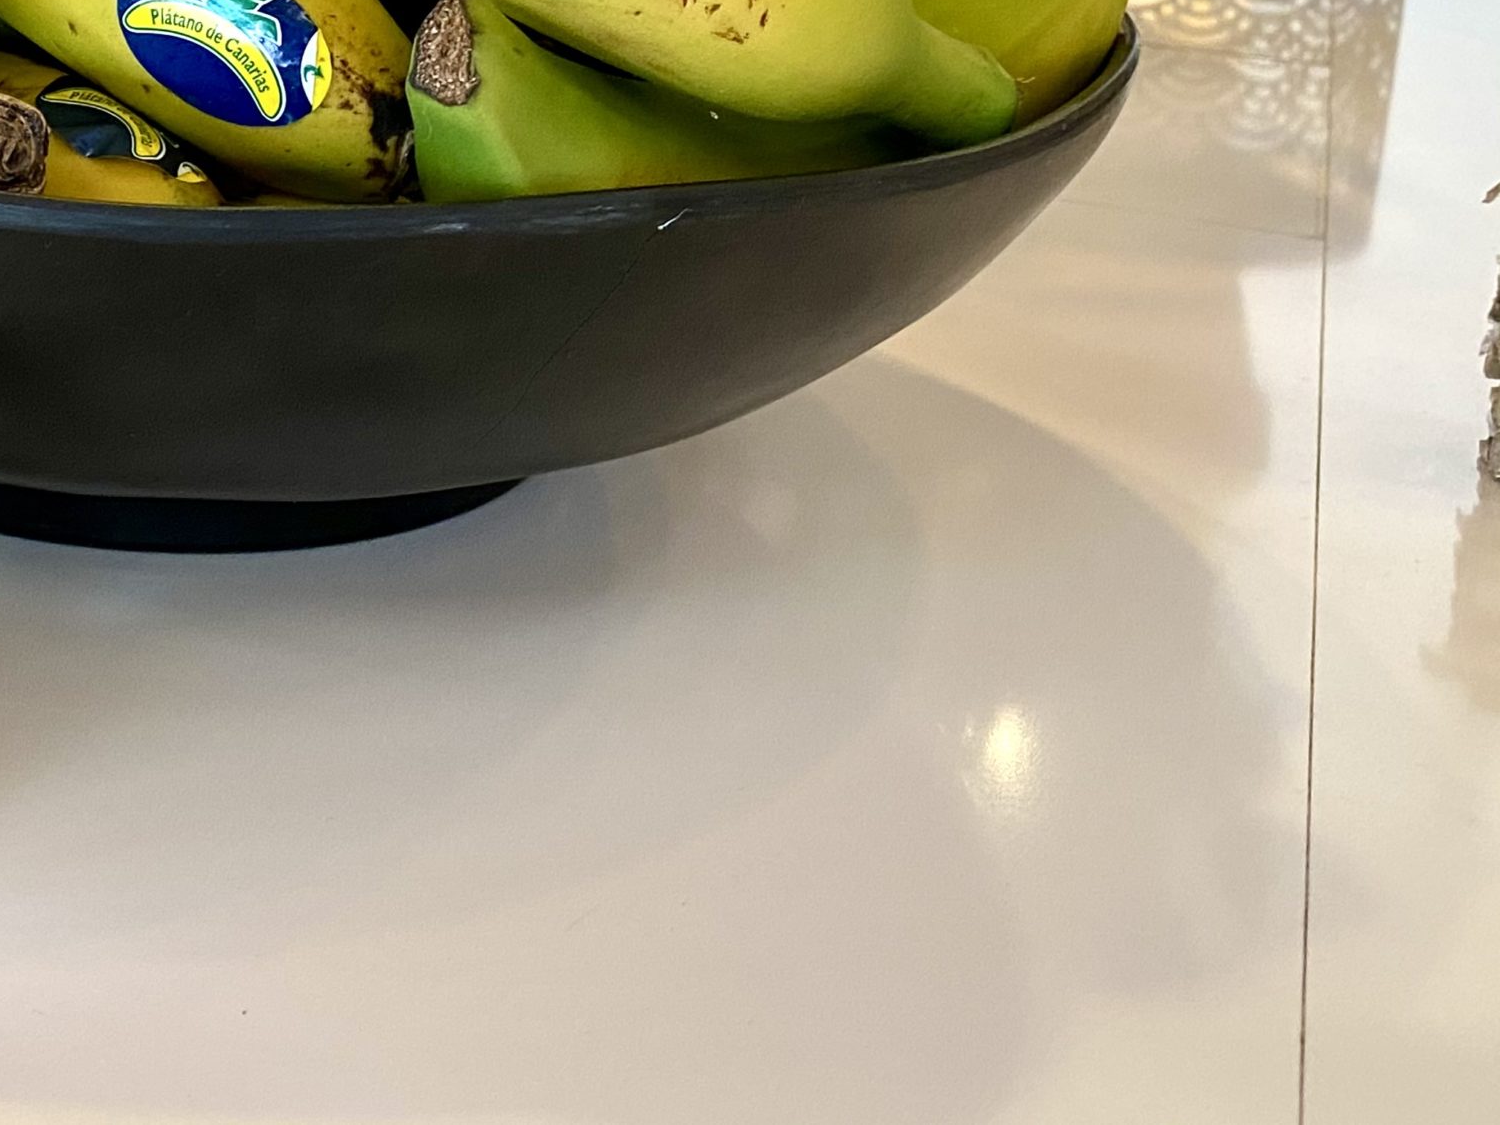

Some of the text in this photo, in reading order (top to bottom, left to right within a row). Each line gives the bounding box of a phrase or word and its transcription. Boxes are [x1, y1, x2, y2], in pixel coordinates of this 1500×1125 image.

[150, 8, 270, 93] Plátano de Canarias
